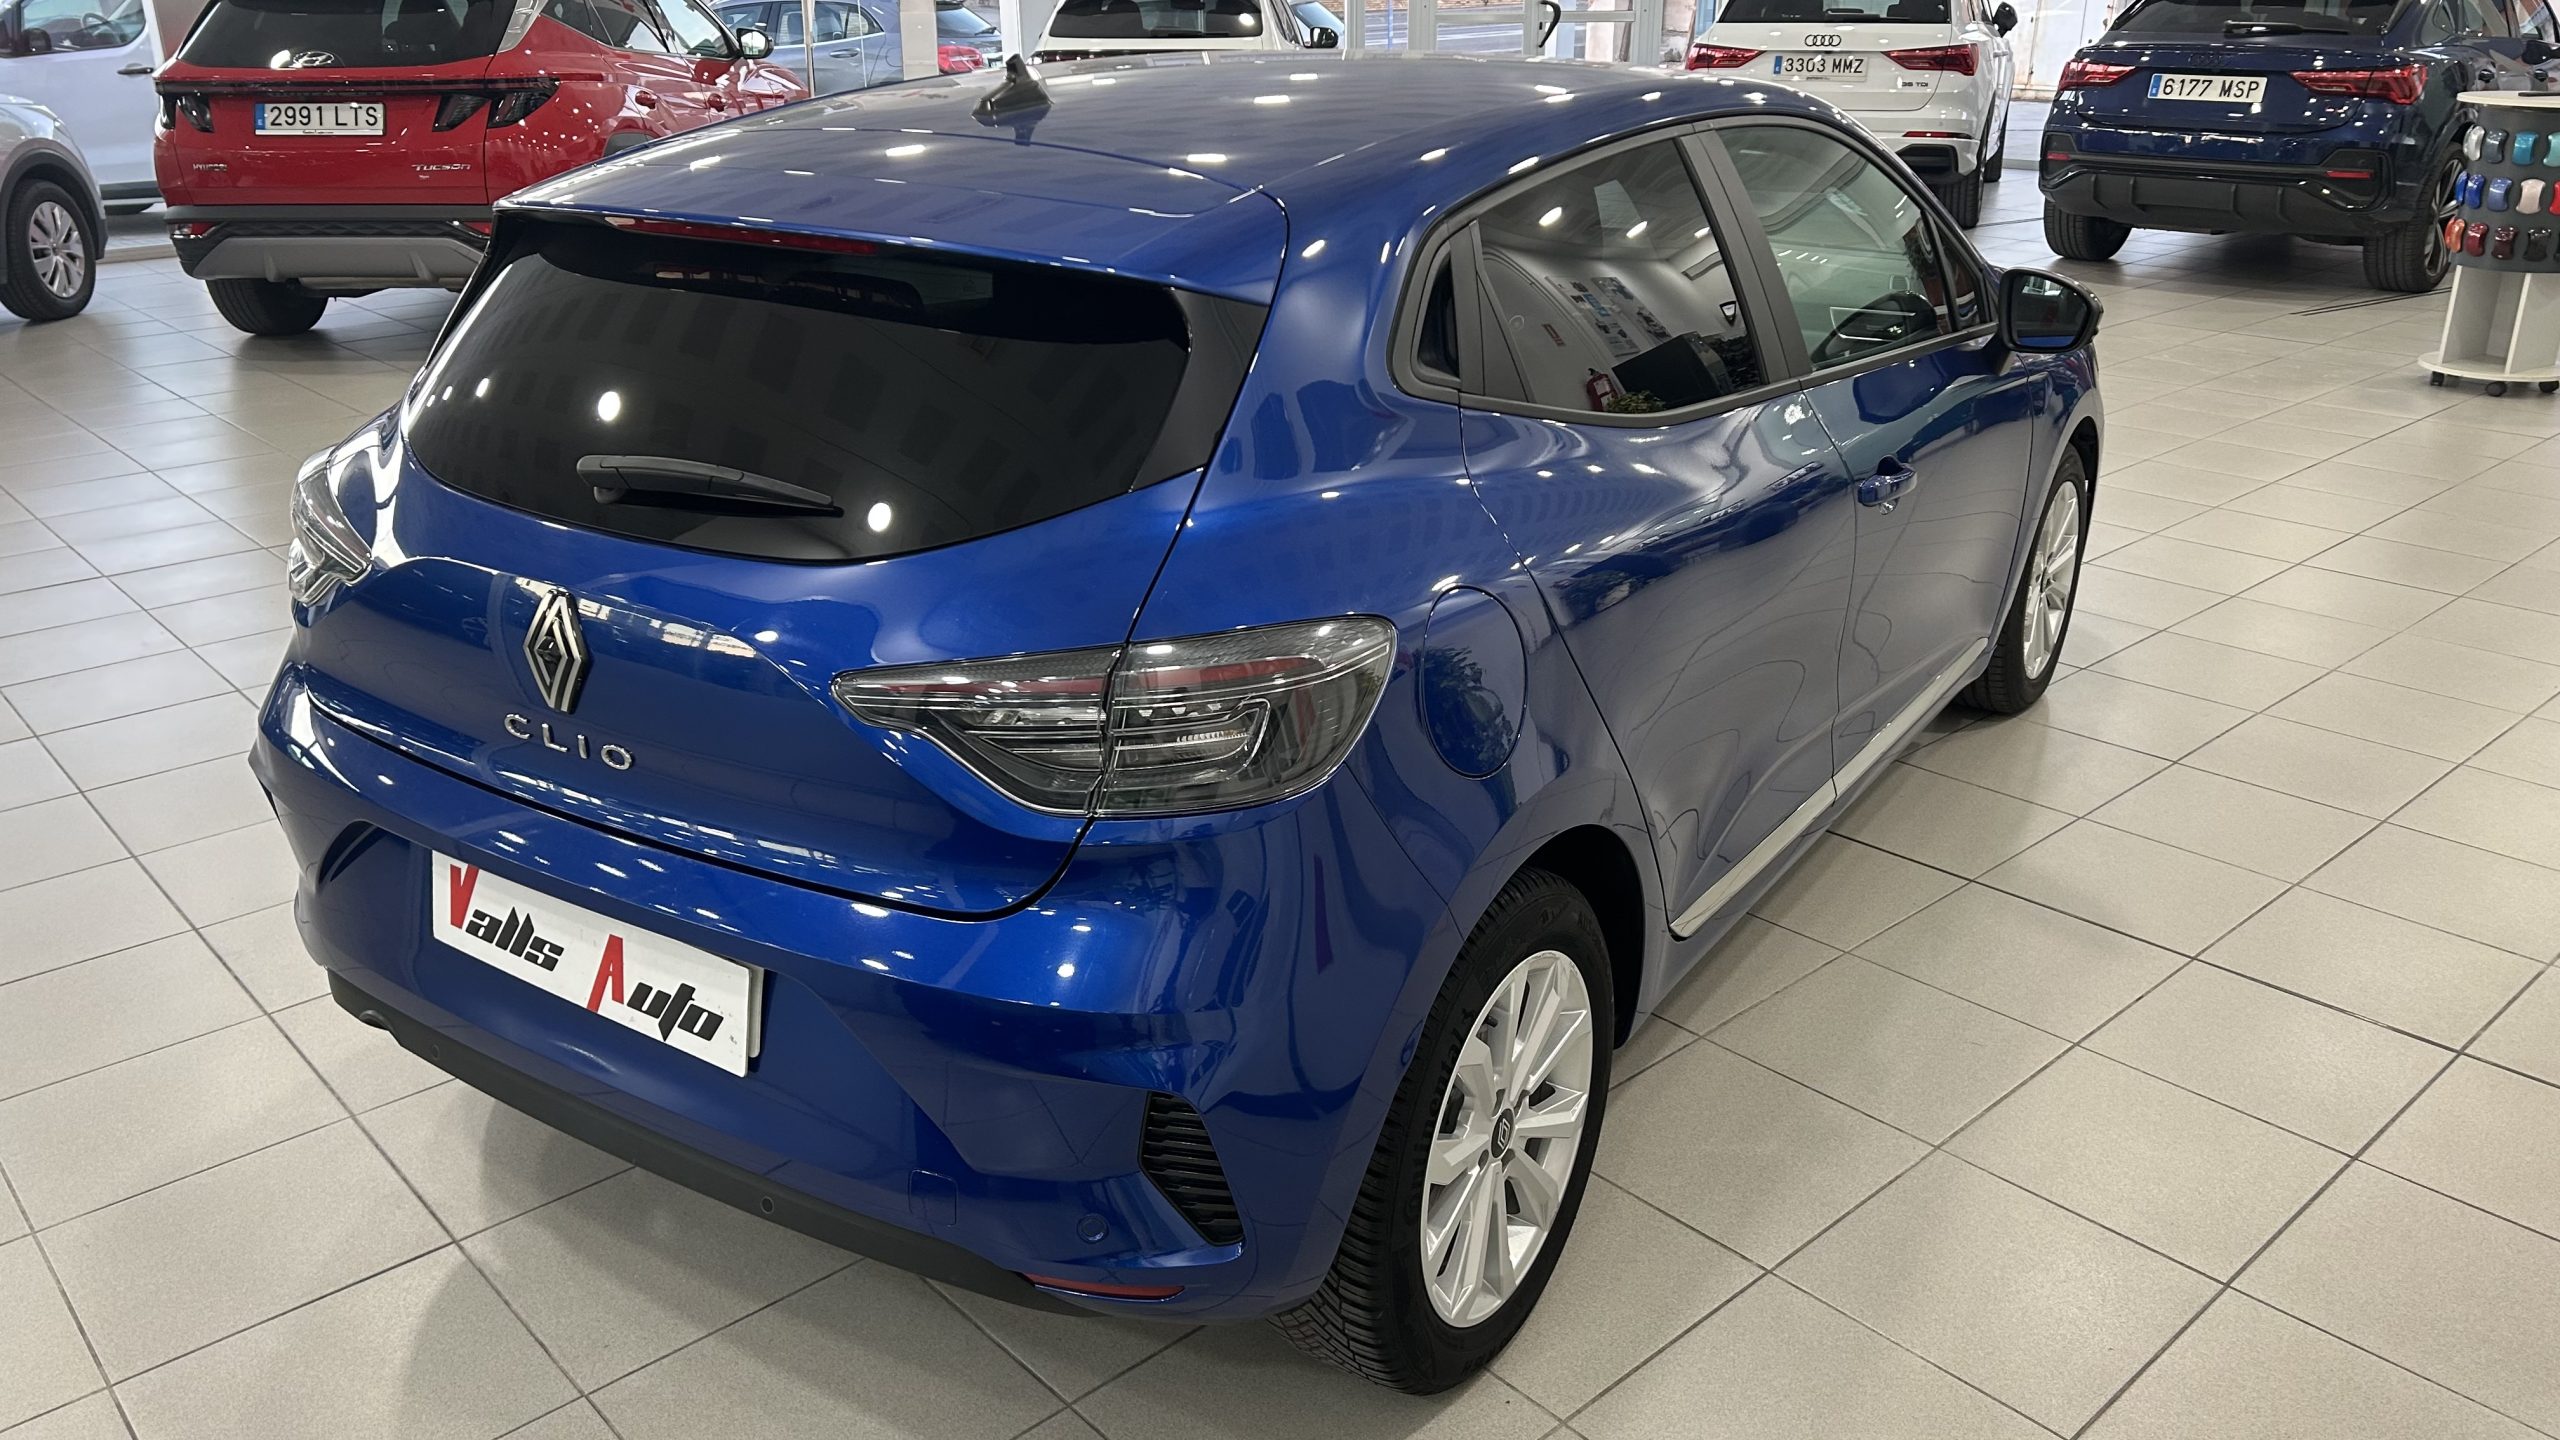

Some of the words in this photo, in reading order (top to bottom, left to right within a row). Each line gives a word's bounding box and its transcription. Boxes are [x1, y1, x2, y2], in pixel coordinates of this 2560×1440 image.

[1785, 58, 1826, 73] 3303
[1831, 58, 1864, 74] MMZ
[2163, 78, 2213, 97] 6177
[2219, 79, 2260, 99] MSP
[270, 106, 323, 126] 2991
[335, 106, 378, 126] LTS
[504, 713, 632, 770] CLIO
[450, 864, 565, 972] Valls
[586, 933, 724, 1042] Auto
